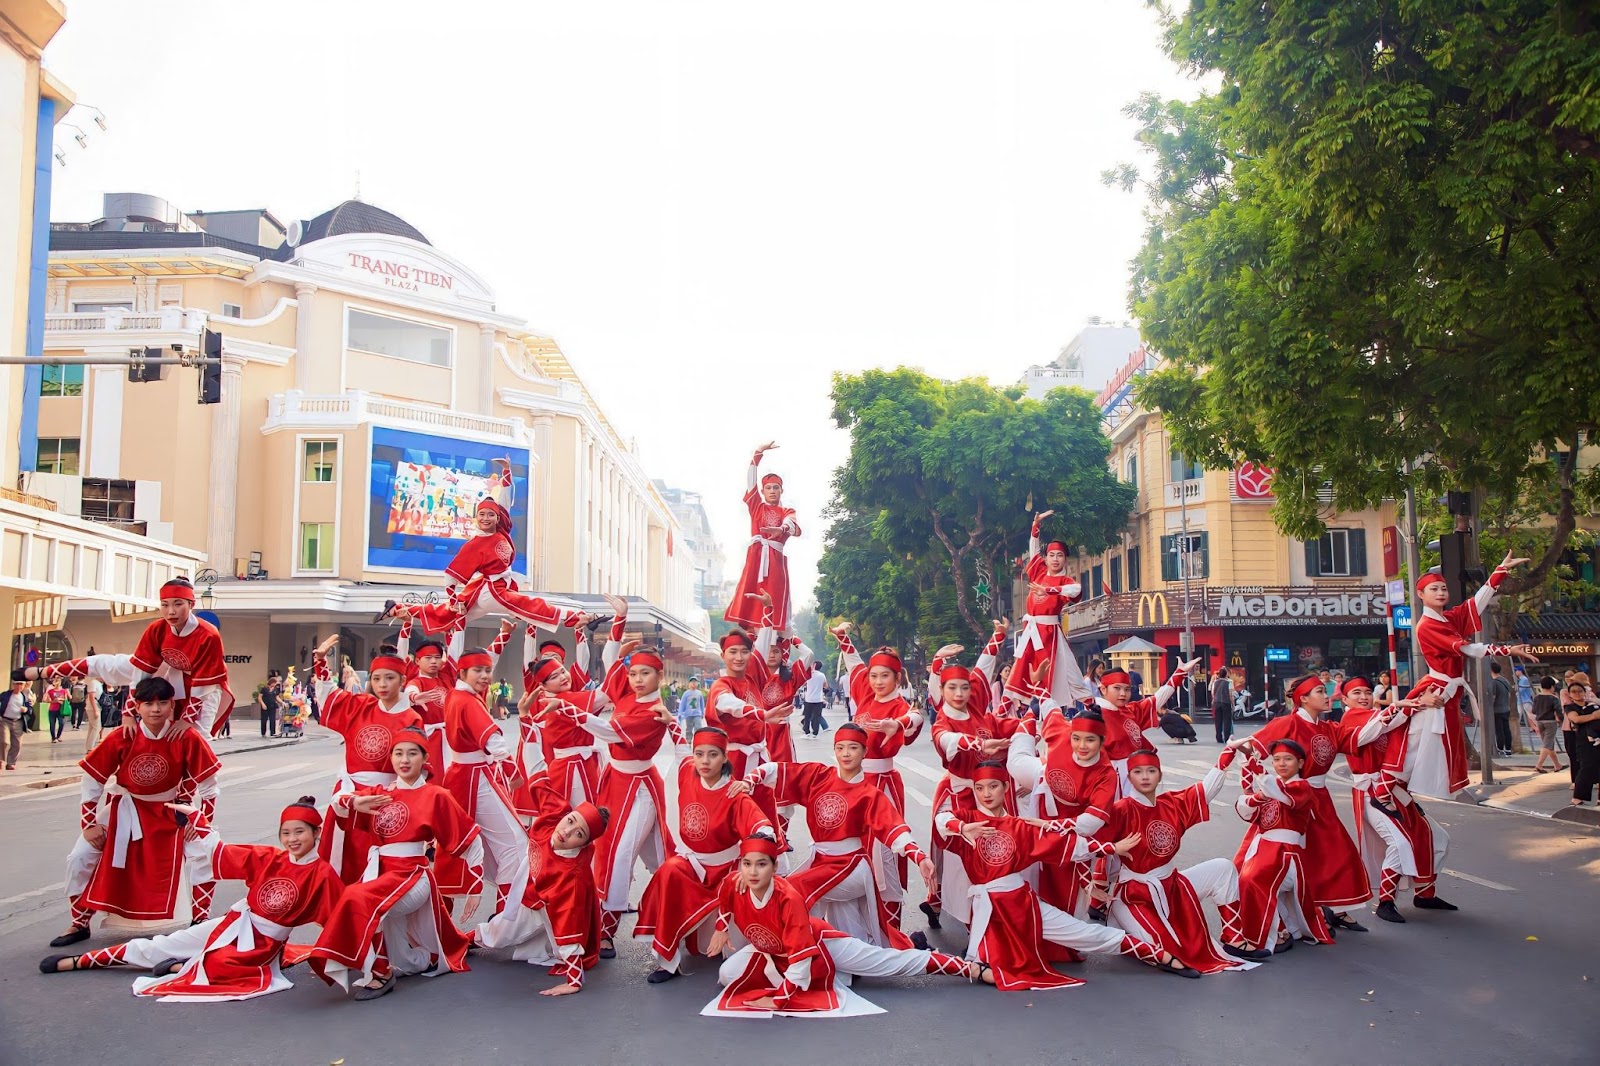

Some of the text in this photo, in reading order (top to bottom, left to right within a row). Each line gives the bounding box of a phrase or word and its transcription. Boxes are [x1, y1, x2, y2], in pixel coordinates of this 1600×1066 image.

[348, 253, 453, 290] TRANG TIEN
[385, 278, 419, 291] PLAZA
[1219, 594, 1387, 616] McDonald's
[1525, 646, 1544, 654] EAD
[223, 655, 252, 663] ERRY
